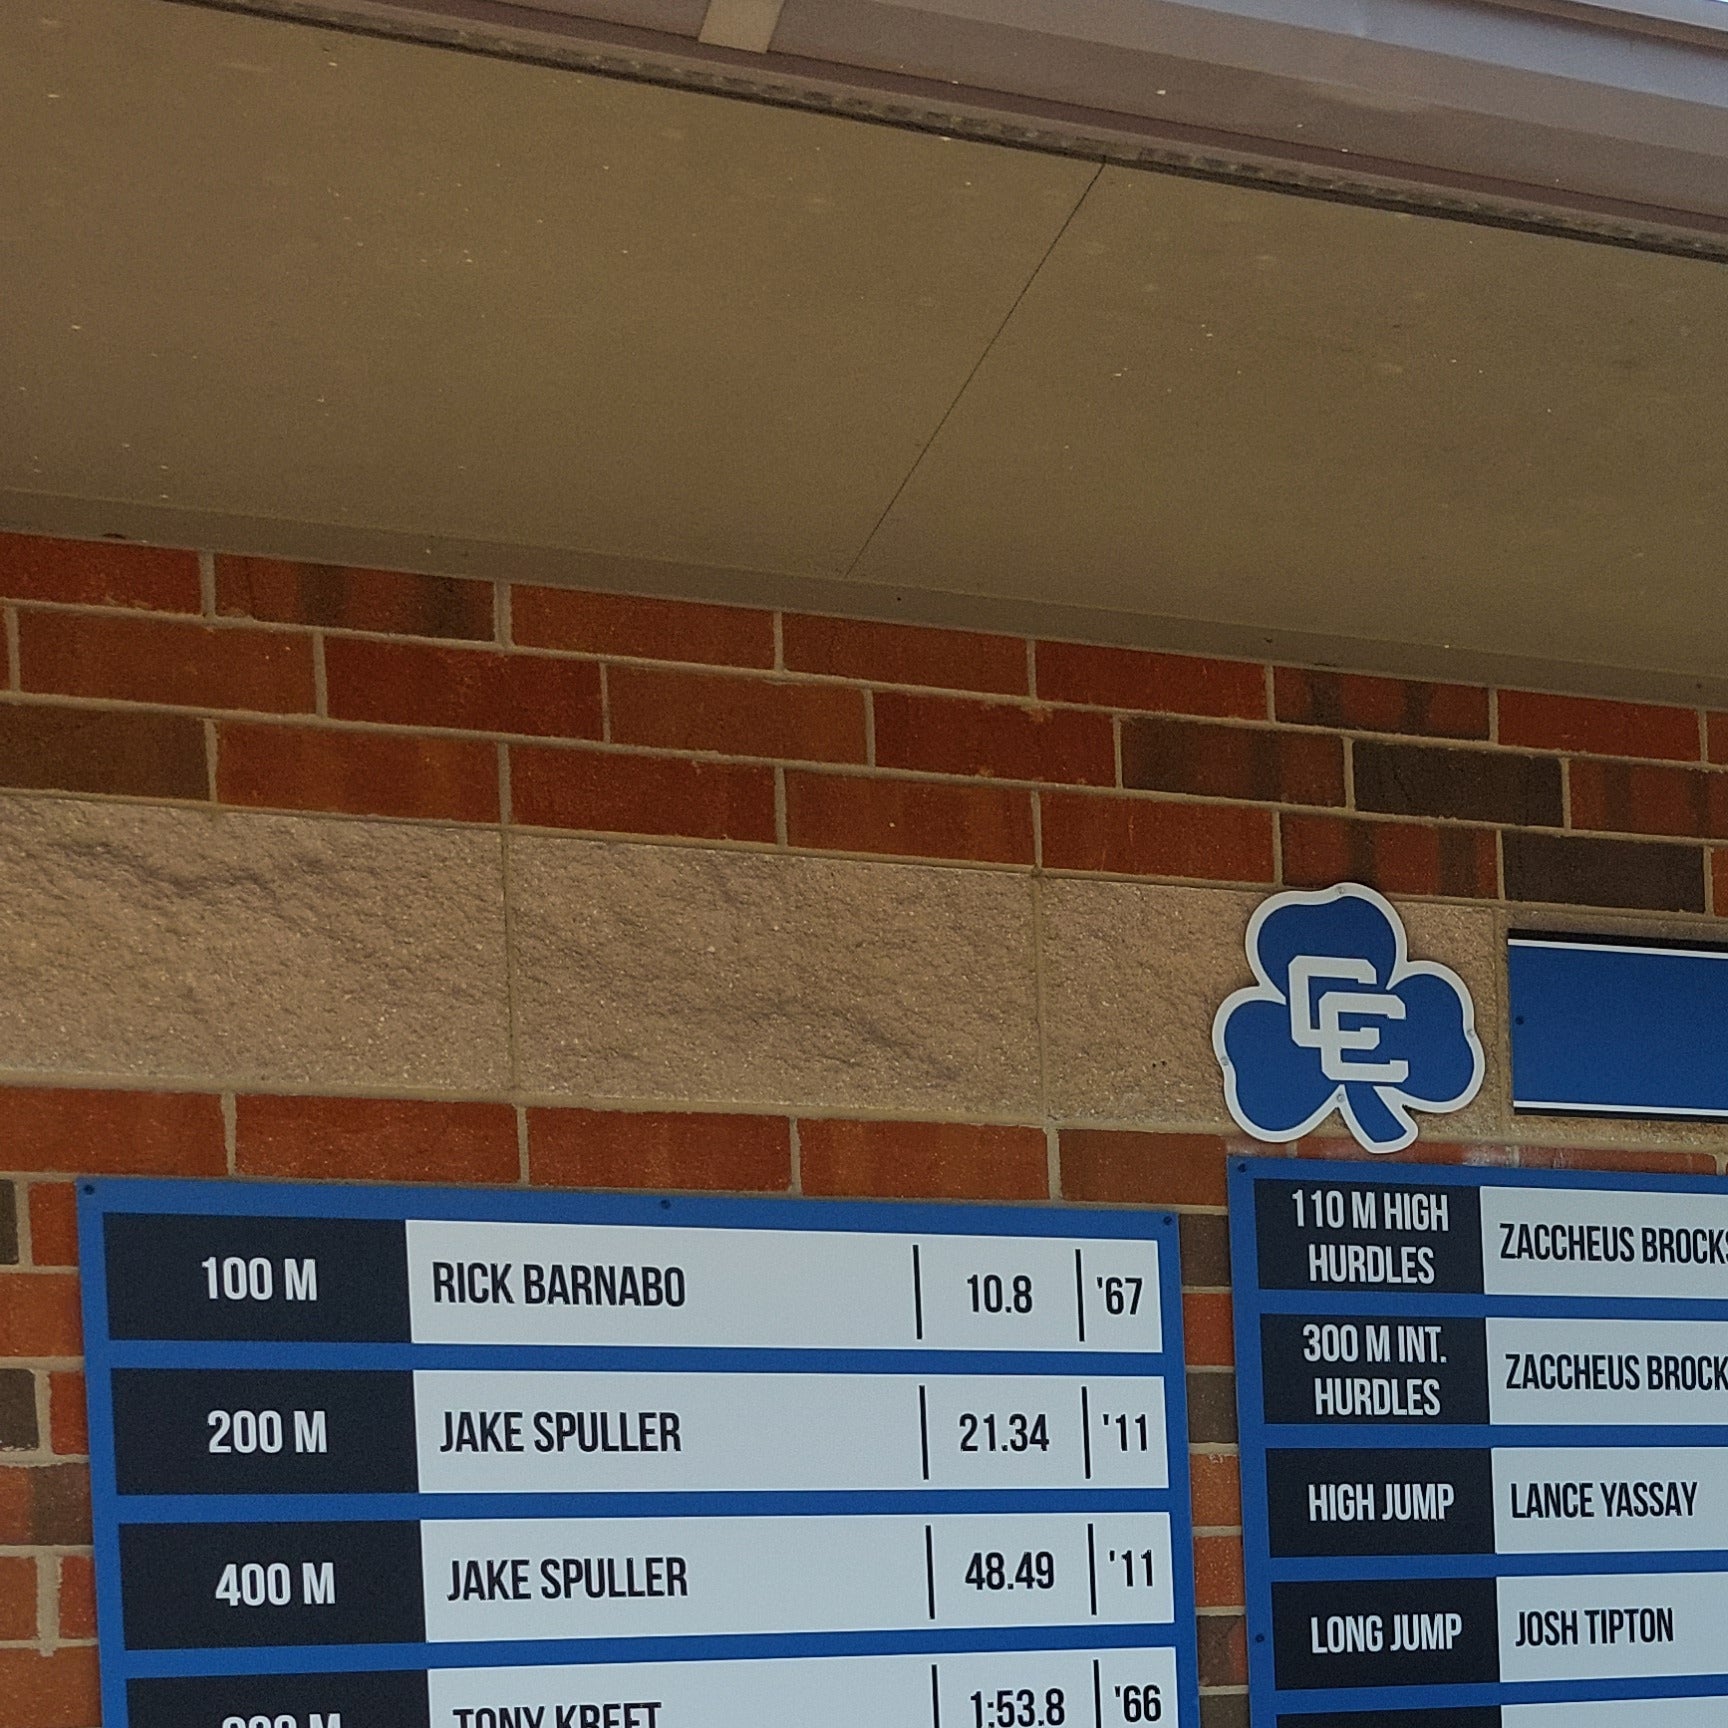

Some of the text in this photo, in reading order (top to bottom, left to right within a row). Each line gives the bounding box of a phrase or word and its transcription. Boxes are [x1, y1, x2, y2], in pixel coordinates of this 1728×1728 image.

[1292, 1189, 1448, 1231] 110 M HIGH
[1500, 1223, 1635, 1262] ZACCHEUS
[202, 1257, 317, 1300] 100 M
[1309, 1244, 1434, 1284] HURDLES
[433, 1262, 685, 1307] RICK BARNABO
[967, 1274, 1032, 1313] 10.8
[1097, 1277, 1142, 1315] '67
[1311, 1613, 1462, 1653] LONG JUMP
[1515, 1607, 1673, 1647] JOSH TIPTON
[970, 1688, 1065, 1728] 1:53.8
[1115, 1685, 1161, 1722] '66
